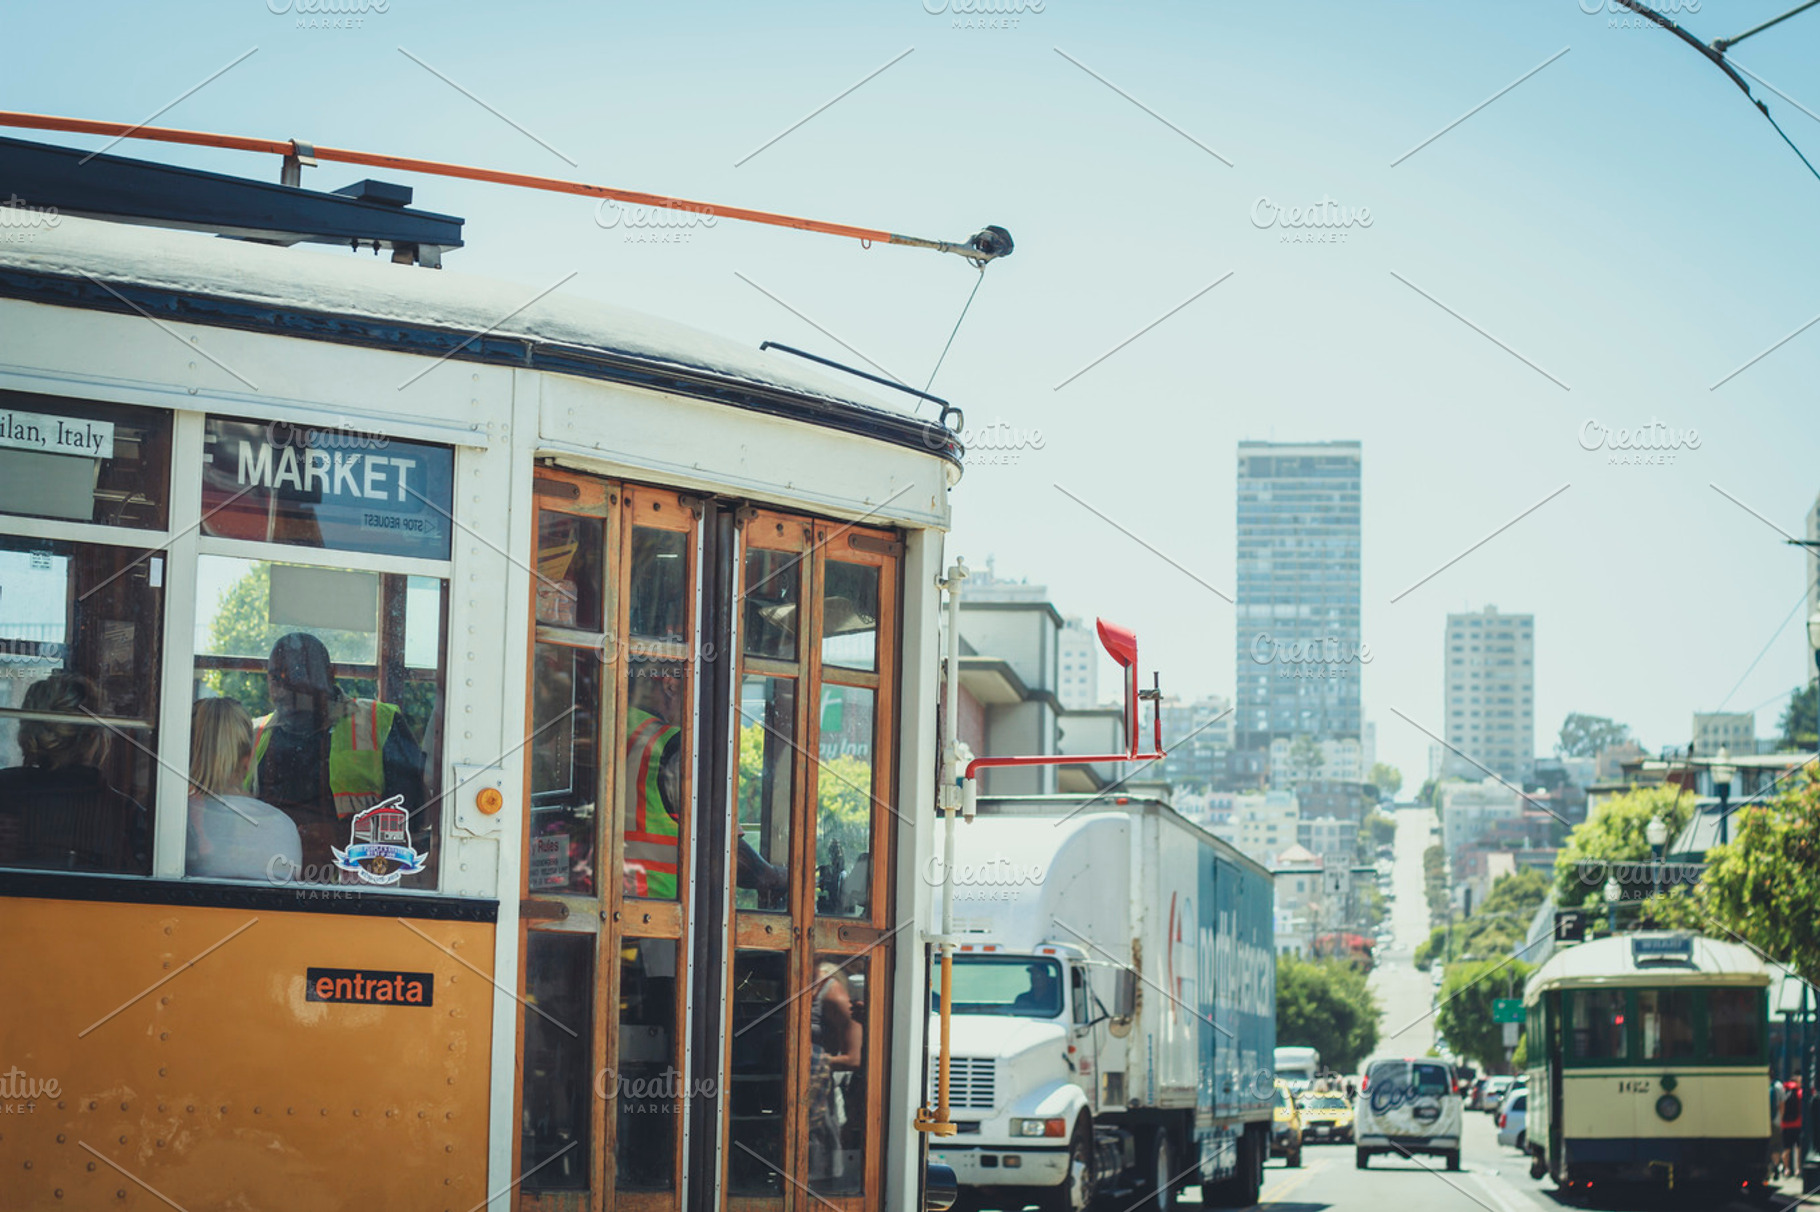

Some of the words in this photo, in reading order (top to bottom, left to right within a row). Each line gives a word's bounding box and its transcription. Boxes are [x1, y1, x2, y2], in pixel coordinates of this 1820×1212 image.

[57, 421, 104, 455] Italy
[238, 440, 416, 502] MARKET
[315, 972, 423, 1003] entrata
